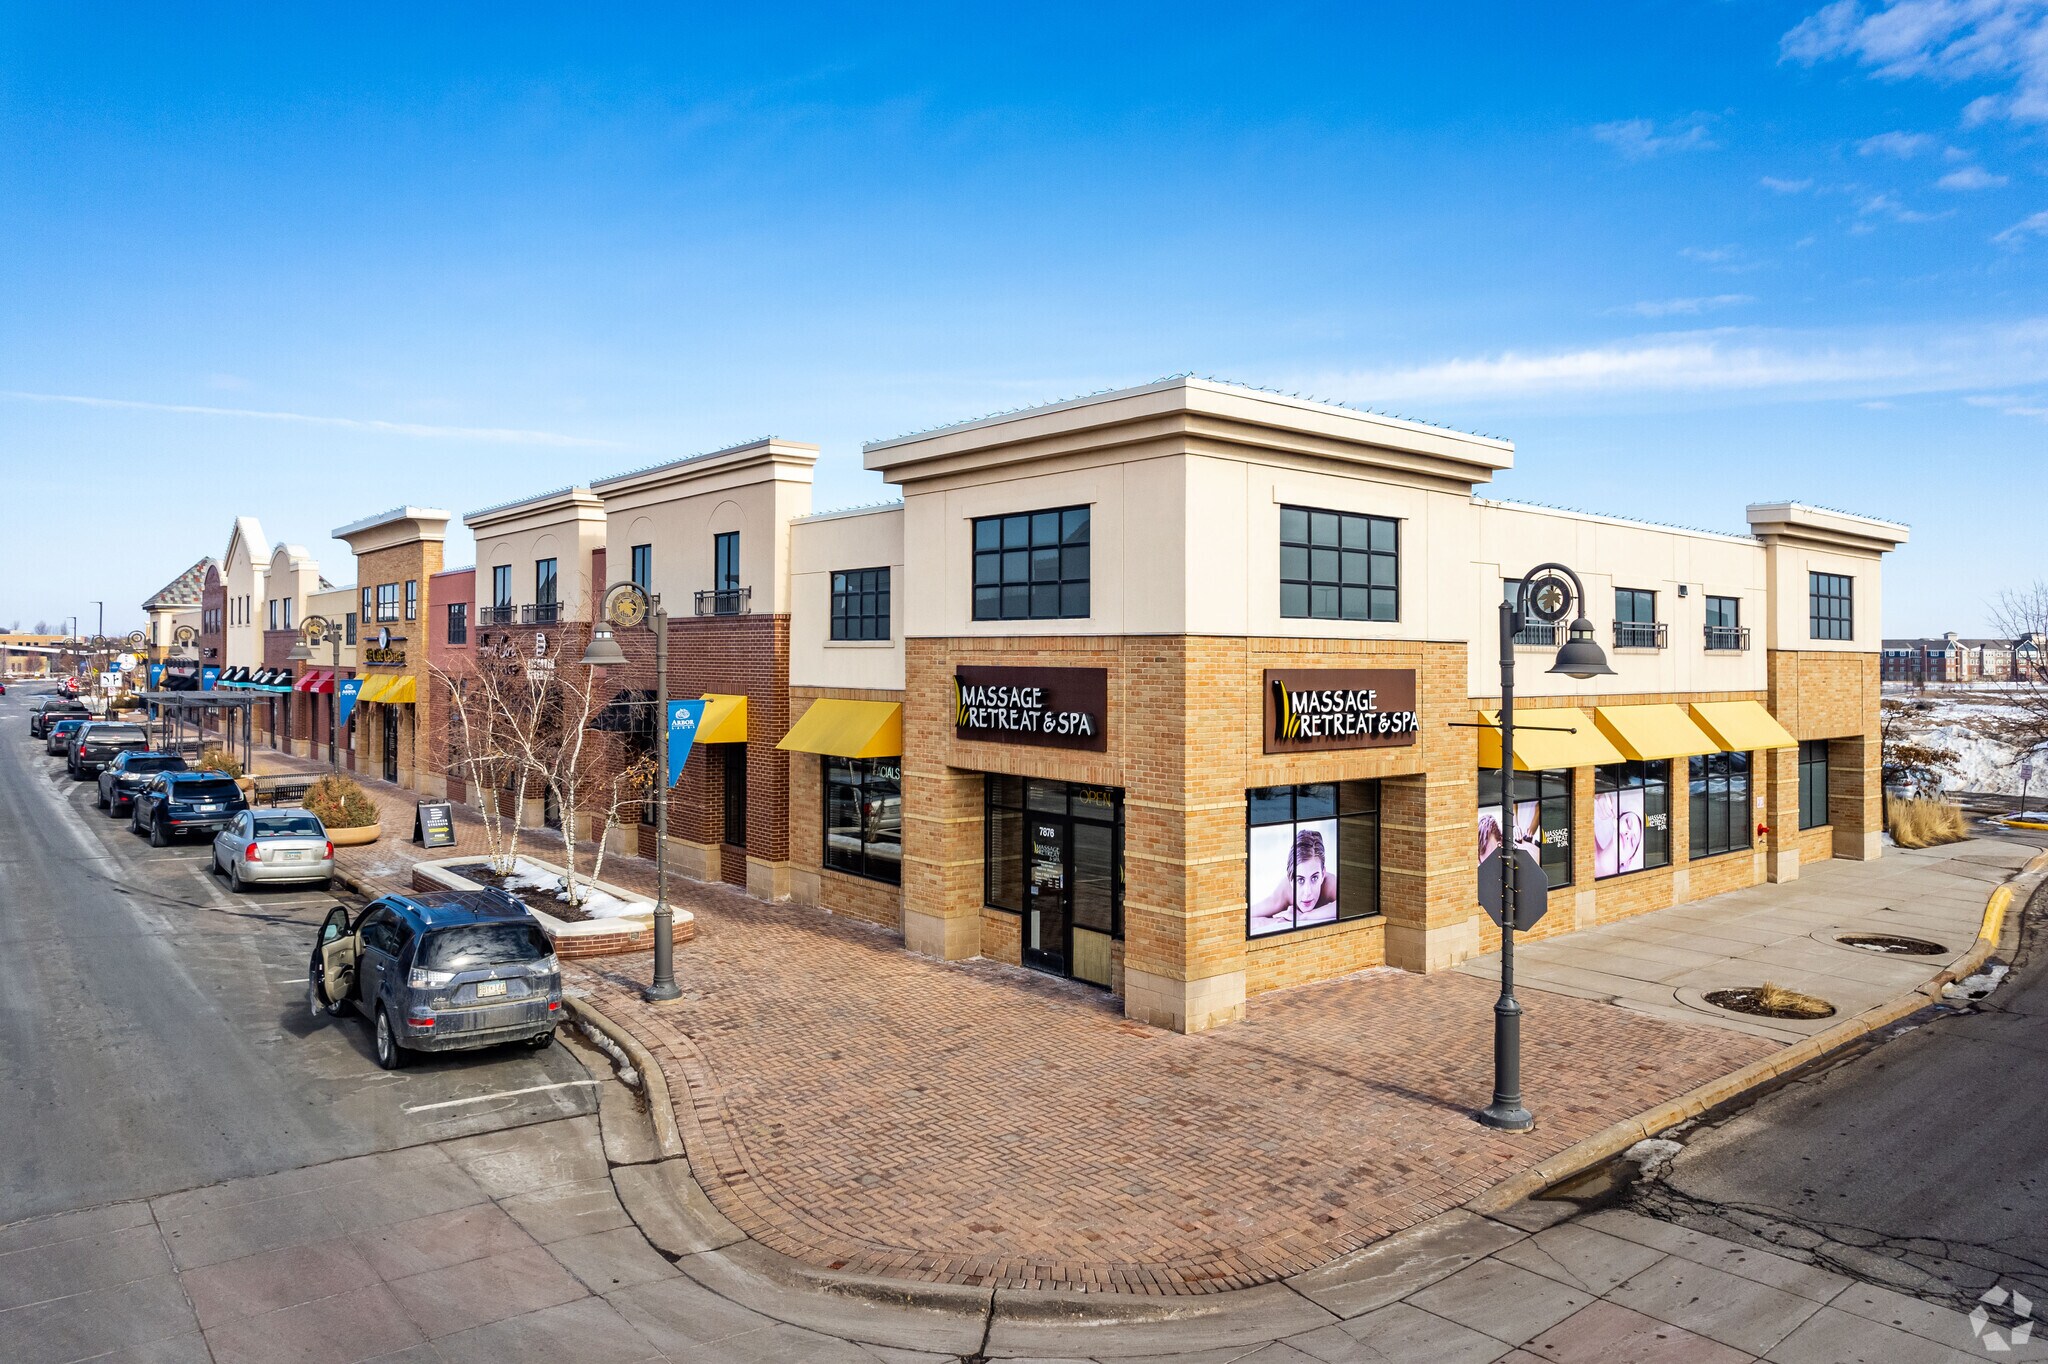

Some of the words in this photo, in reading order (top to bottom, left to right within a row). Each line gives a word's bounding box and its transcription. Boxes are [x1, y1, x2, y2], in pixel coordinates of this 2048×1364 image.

[962, 685, 1042, 708] MASSAGE
[1292, 690, 1377, 713] MASSAGE
[969, 707, 1040, 731] RETREAT
[1043, 711, 1056, 733] &
[1057, 711, 1091, 736] SPA
[1300, 713, 1376, 737] RETREAT
[1379, 712, 1391, 733] &
[1391, 711, 1420, 732] SPA
[1080, 789, 1111, 807] OPEN
